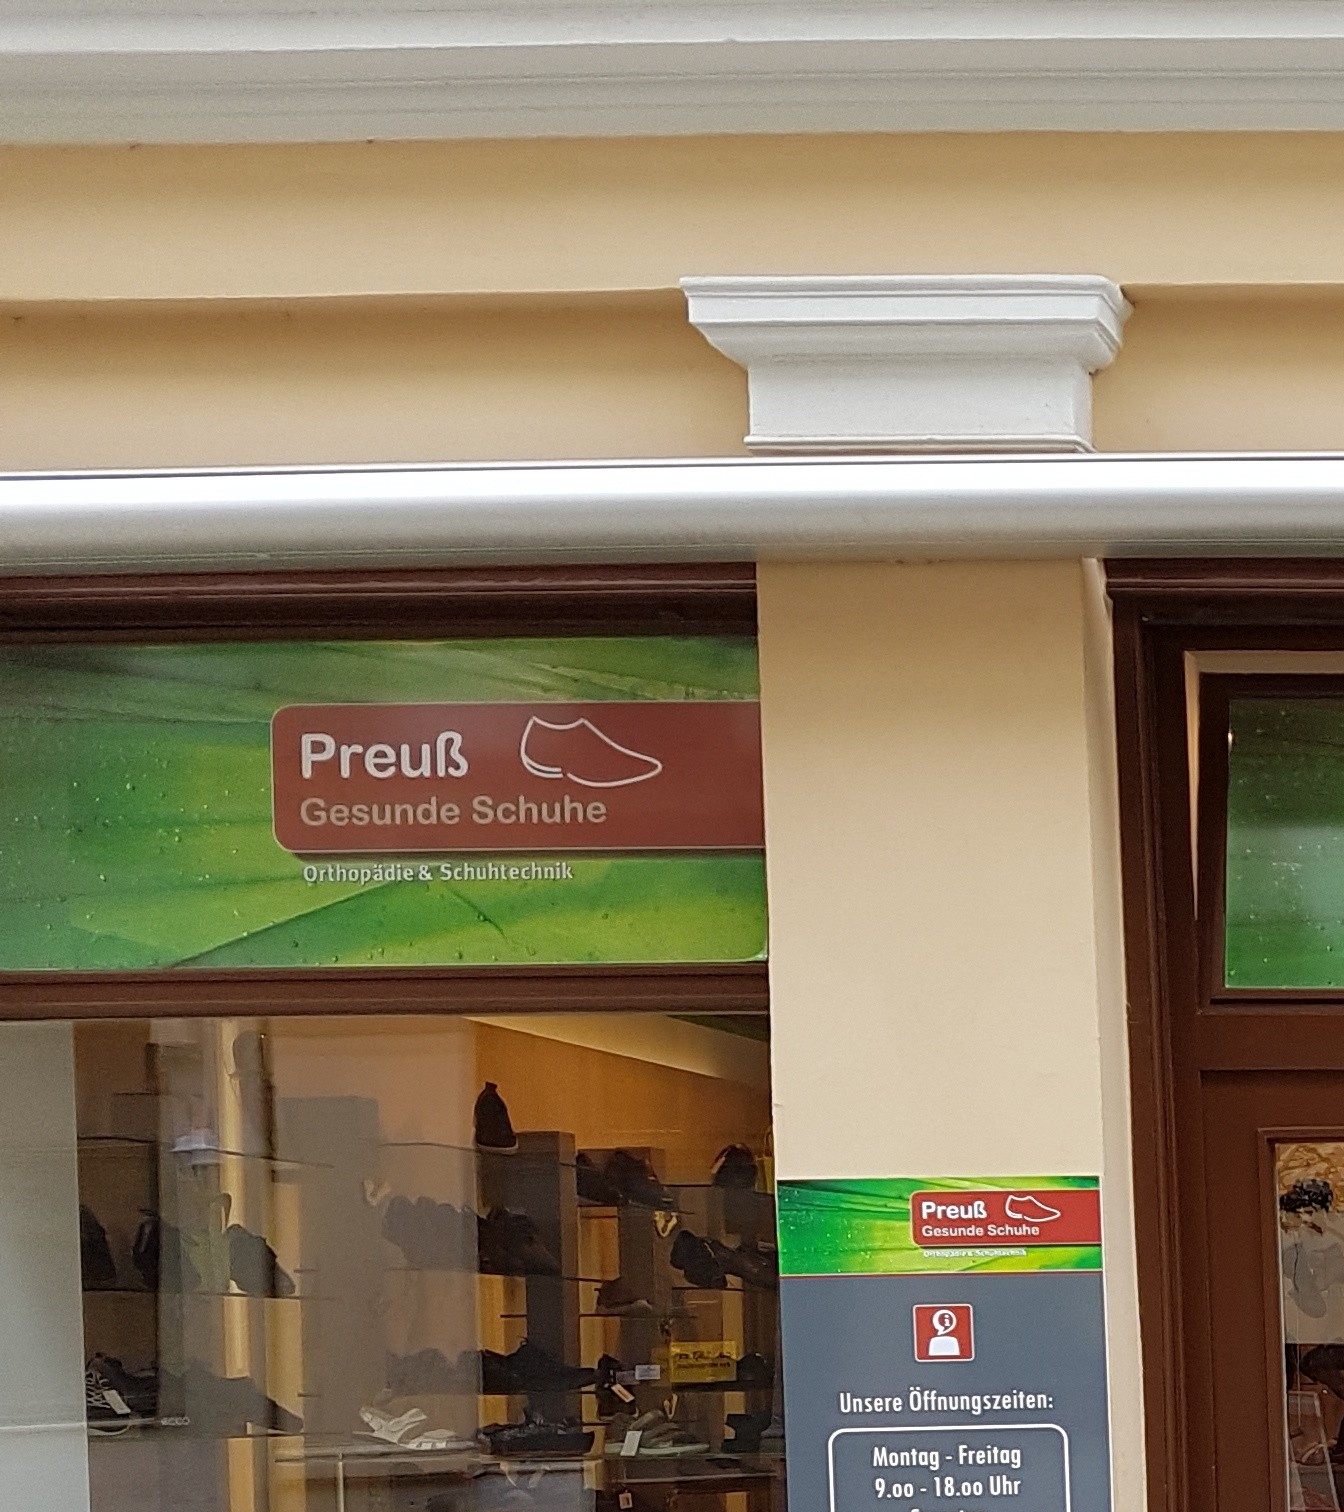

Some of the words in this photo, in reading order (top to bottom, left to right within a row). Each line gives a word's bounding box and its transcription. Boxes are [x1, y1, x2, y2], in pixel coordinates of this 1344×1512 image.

[302, 732, 468, 779] Preuß
[301, 797, 460, 828] Gesunde
[471, 795, 607, 826] Schuhe
[303, 861, 415, 885] Orthopädie
[419, 863, 433, 882] &
[439, 861, 574, 882] Schuhtechnik
[921, 1201, 987, 1220] Preuß
[921, 1224, 984, 1237] Gesunde
[987, 1223, 1040, 1237] Schuhe
[839, 1392, 902, 1413] Unsere
[909, 1387, 1054, 1415] Öffnungszeiten:
[873, 1447, 940, 1471] Montag
[958, 1446, 1022, 1469] Freitag
[989, 1475, 1021, 1495] Uhr
